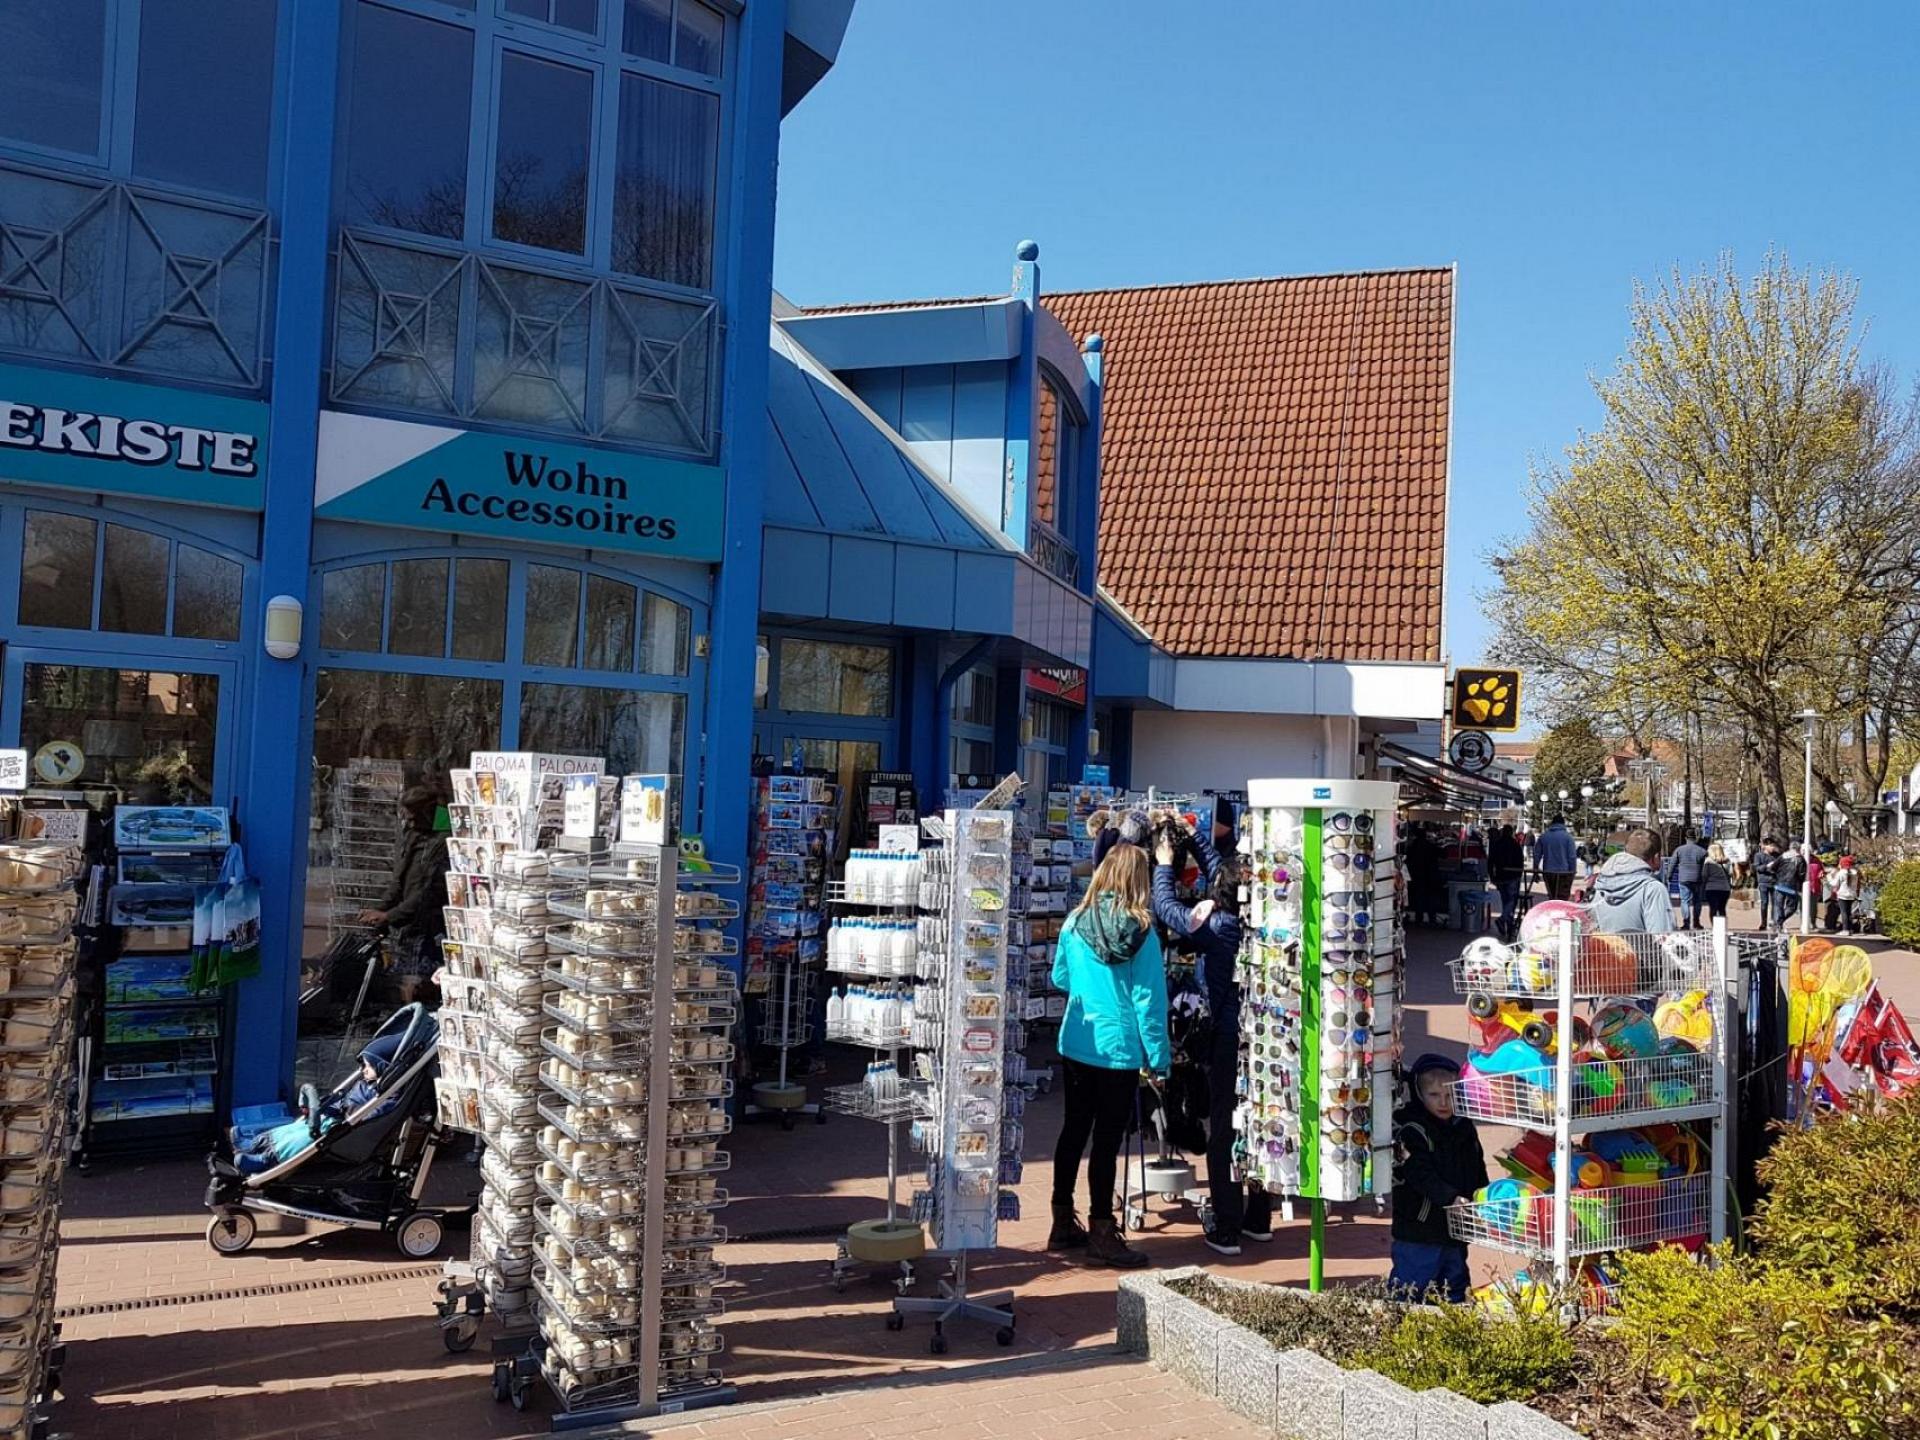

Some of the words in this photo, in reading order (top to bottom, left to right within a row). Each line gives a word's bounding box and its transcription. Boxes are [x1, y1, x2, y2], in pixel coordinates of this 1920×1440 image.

[503, 450, 629, 500] Wohn
[420, 477, 677, 541] Accessoires
[475, 756, 526, 772] PALOMA
[539, 757, 599, 774] PALOMA
